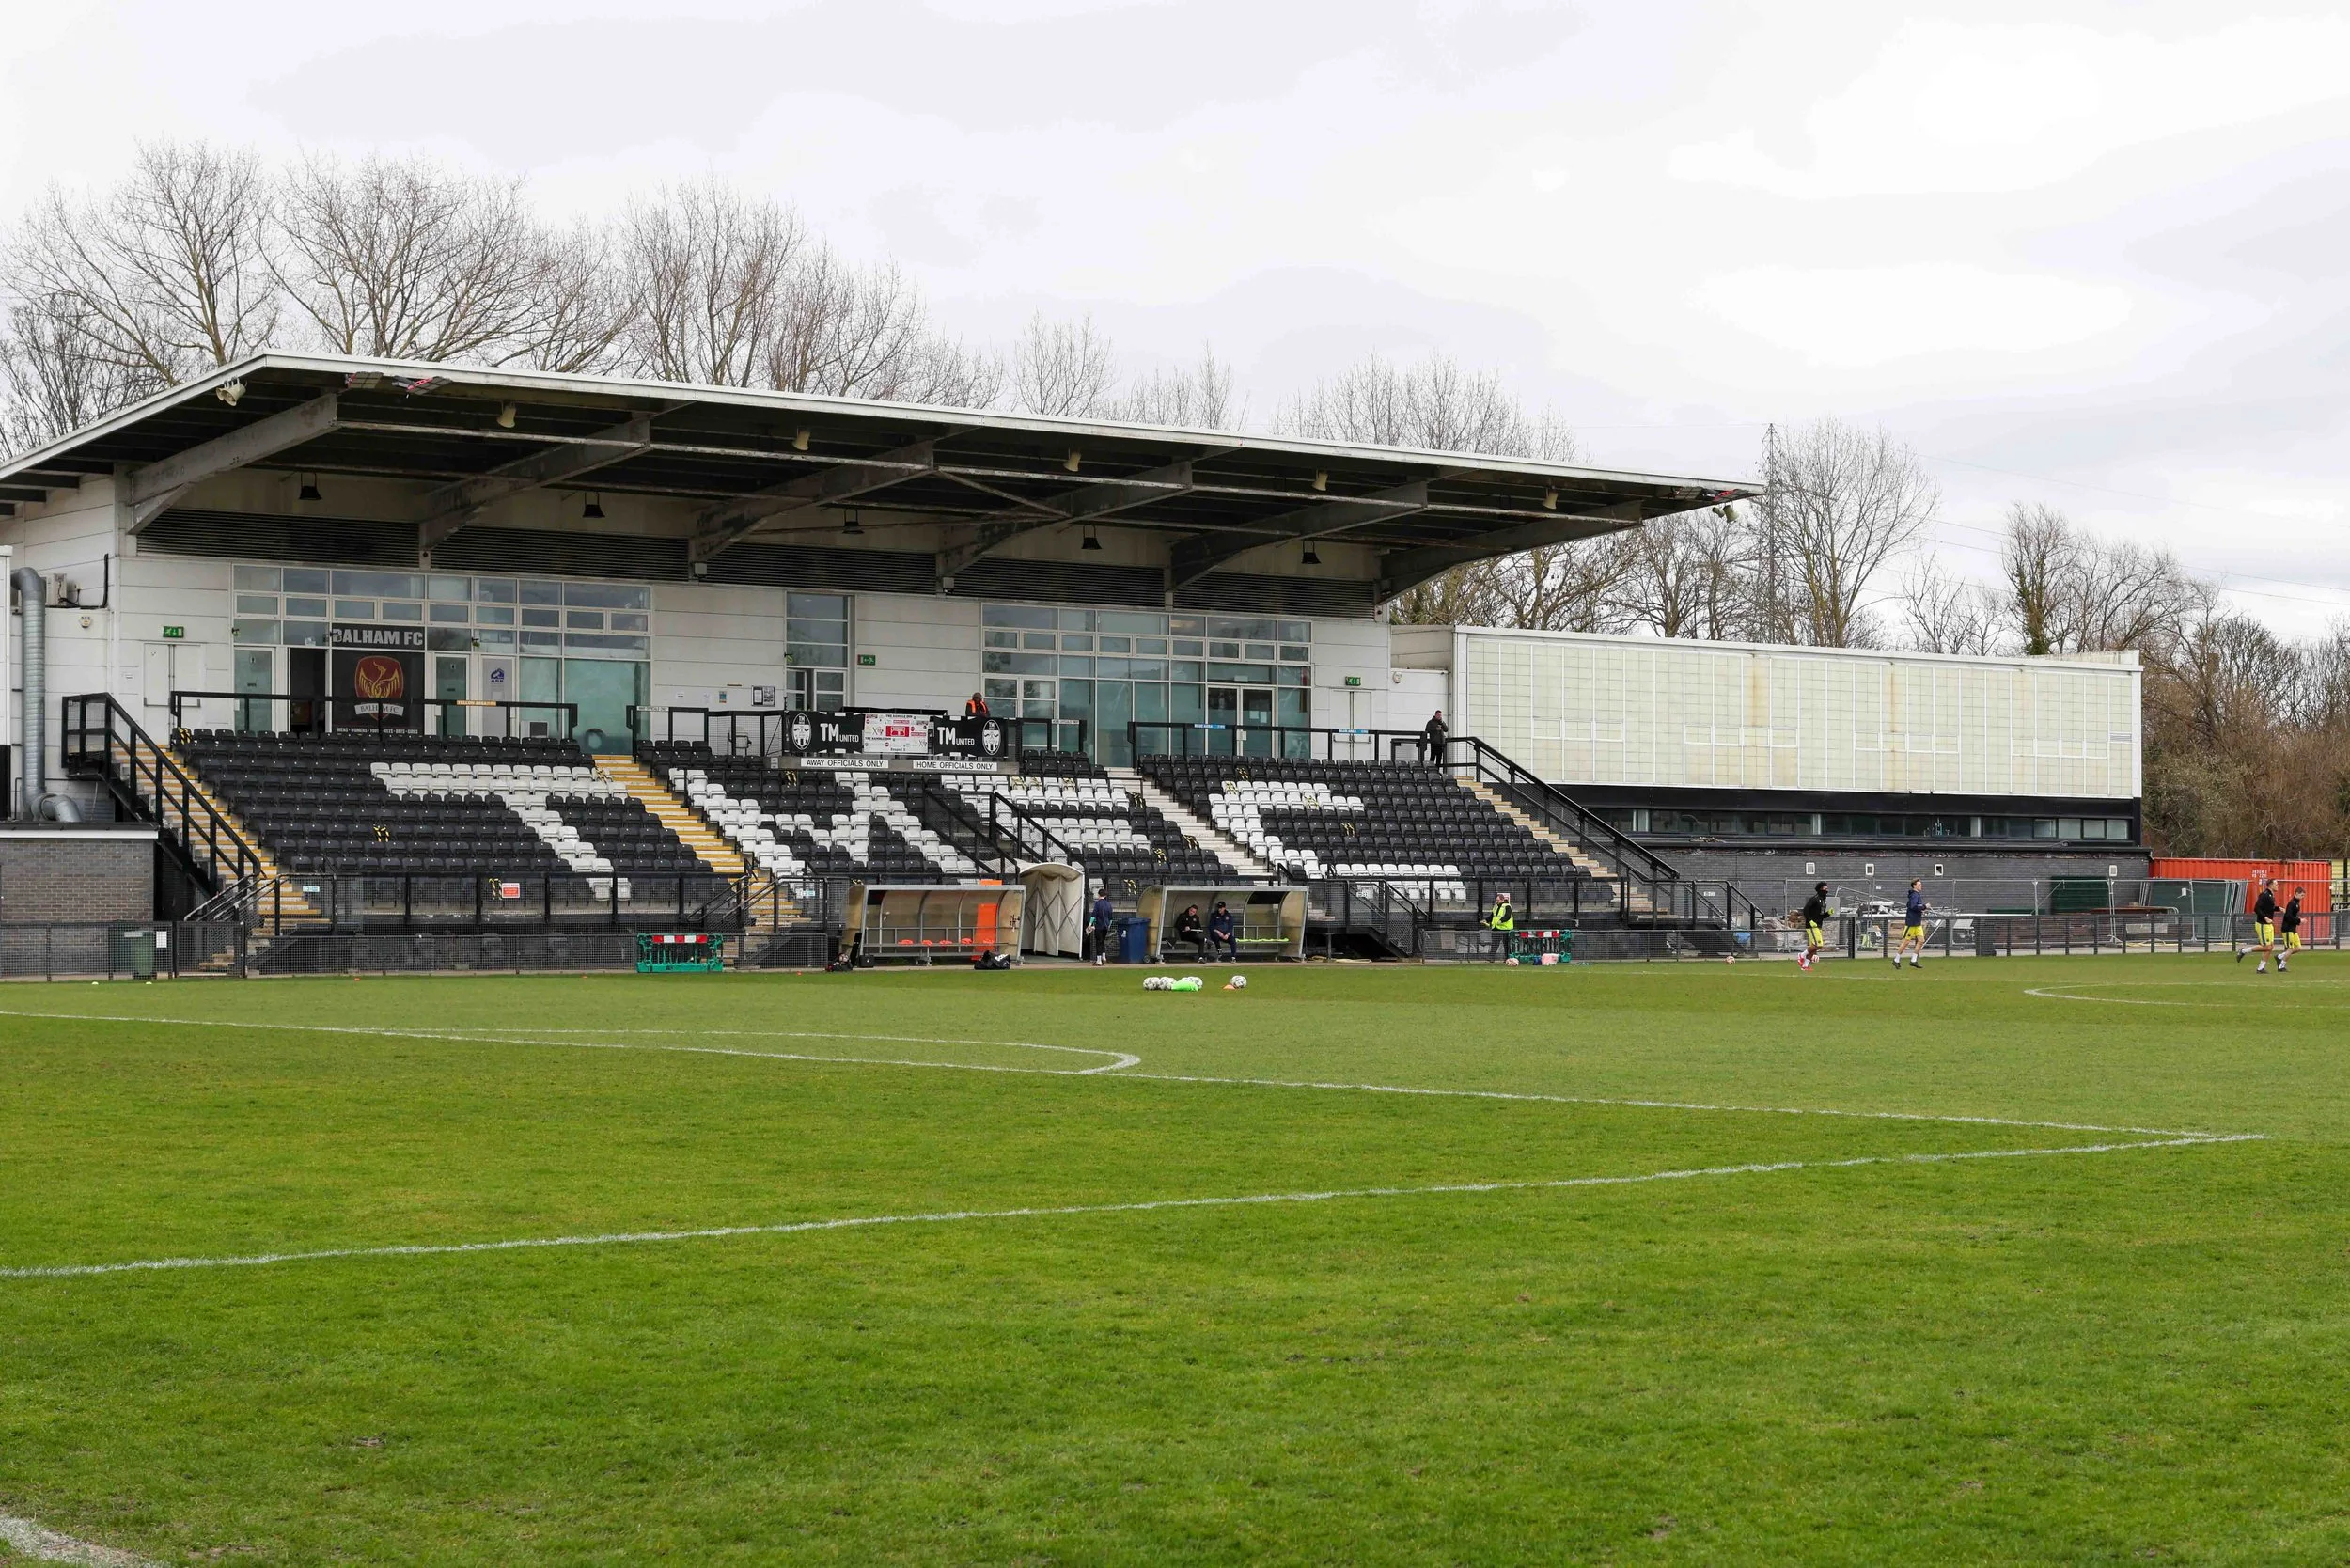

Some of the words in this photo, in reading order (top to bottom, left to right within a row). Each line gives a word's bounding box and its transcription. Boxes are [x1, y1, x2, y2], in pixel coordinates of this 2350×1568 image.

[332, 628, 400, 645] BALHAM
[403, 631, 423, 646] FC
[360, 704, 388, 713] BALHM
[820, 723, 839, 742] TM
[839, 734, 859, 743] UNITED
[936, 726, 956, 745] TM
